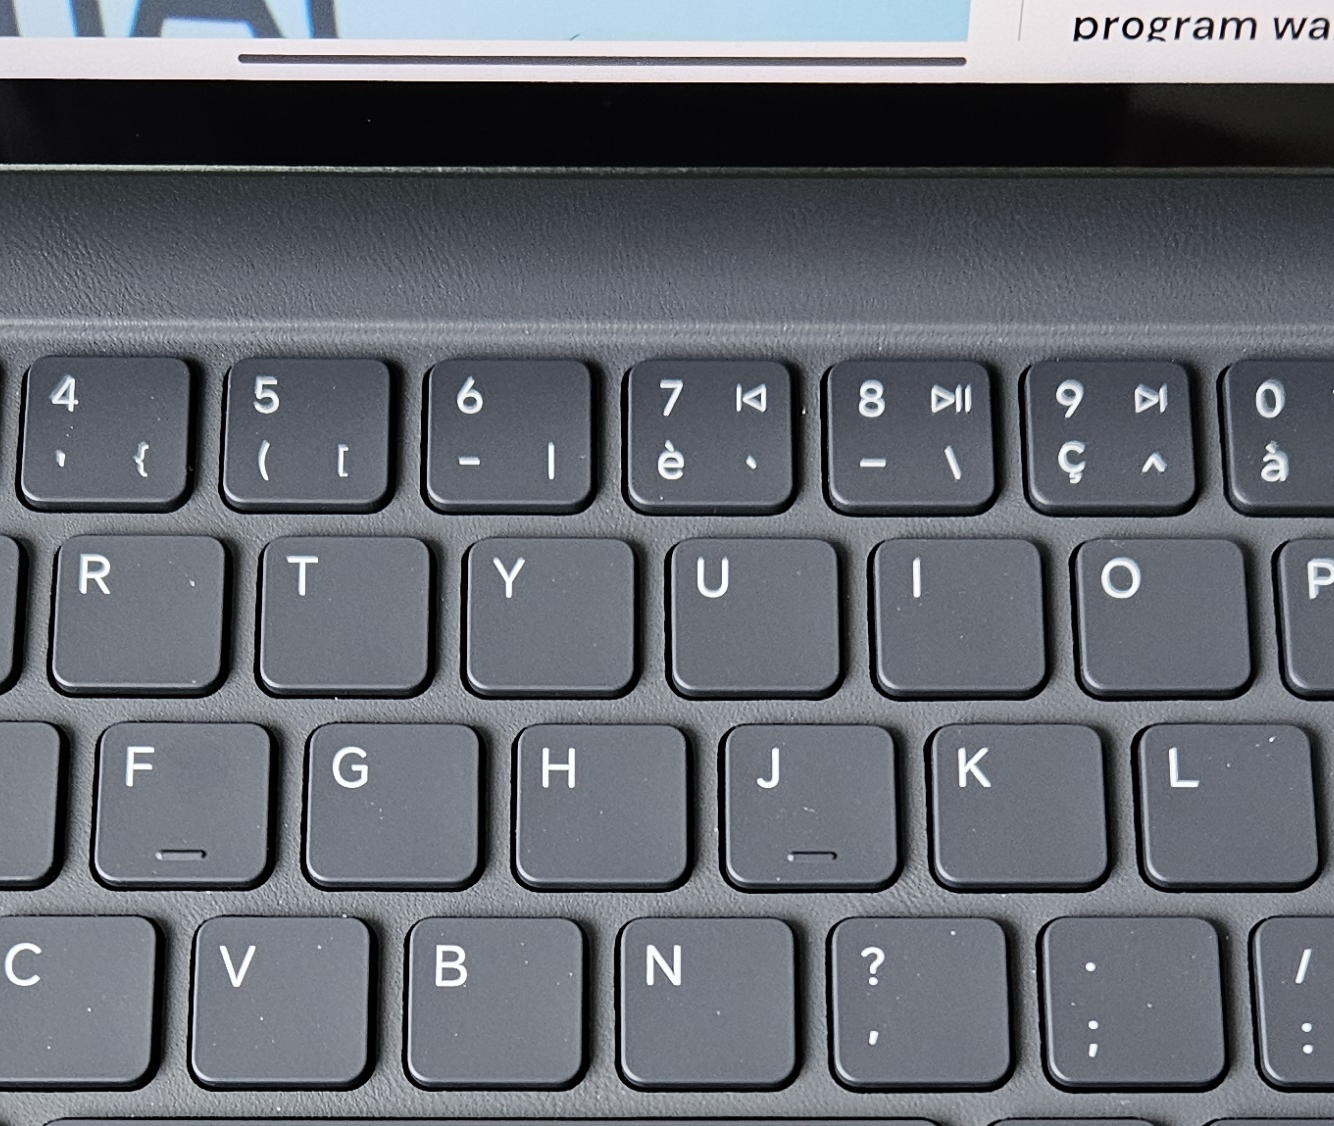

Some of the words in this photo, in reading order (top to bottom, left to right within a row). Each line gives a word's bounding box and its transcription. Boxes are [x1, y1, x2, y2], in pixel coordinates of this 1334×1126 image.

[1072, 16, 1258, 43] program
[50, 375, 79, 413] 4
[253, 376, 280, 415] 5
[456, 376, 484, 415] 6
[659, 379, 684, 417] 7
[858, 380, 886, 418] 8
[1055, 380, 1084, 419] 9
[133, 441, 150, 478] {
[258, 440, 271, 481] (
[337, 444, 349, 478] [
[657, 439, 685, 480] è
[944, 445, 962, 480] \
[1260, 442, 1289, 483] à
[79, 553, 111, 595] R
[286, 555, 319, 596] T
[493, 557, 526, 599] Y
[696, 556, 729, 599] U
[1100, 557, 1141, 599] O
[125, 746, 155, 787] F
[332, 746, 369, 789] G
[542, 747, 576, 789] H
[756, 747, 780, 789] J
[957, 747, 992, 788] K
[1168, 746, 1200, 788] L
[4, 942, 42, 987] C
[219, 945, 257, 988] V
[435, 944, 468, 987] B
[646, 944, 682, 986] N
[860, 946, 885, 986] ?
[1295, 948, 1312, 984] /
[1301, 1022, 1314, 1054] :
